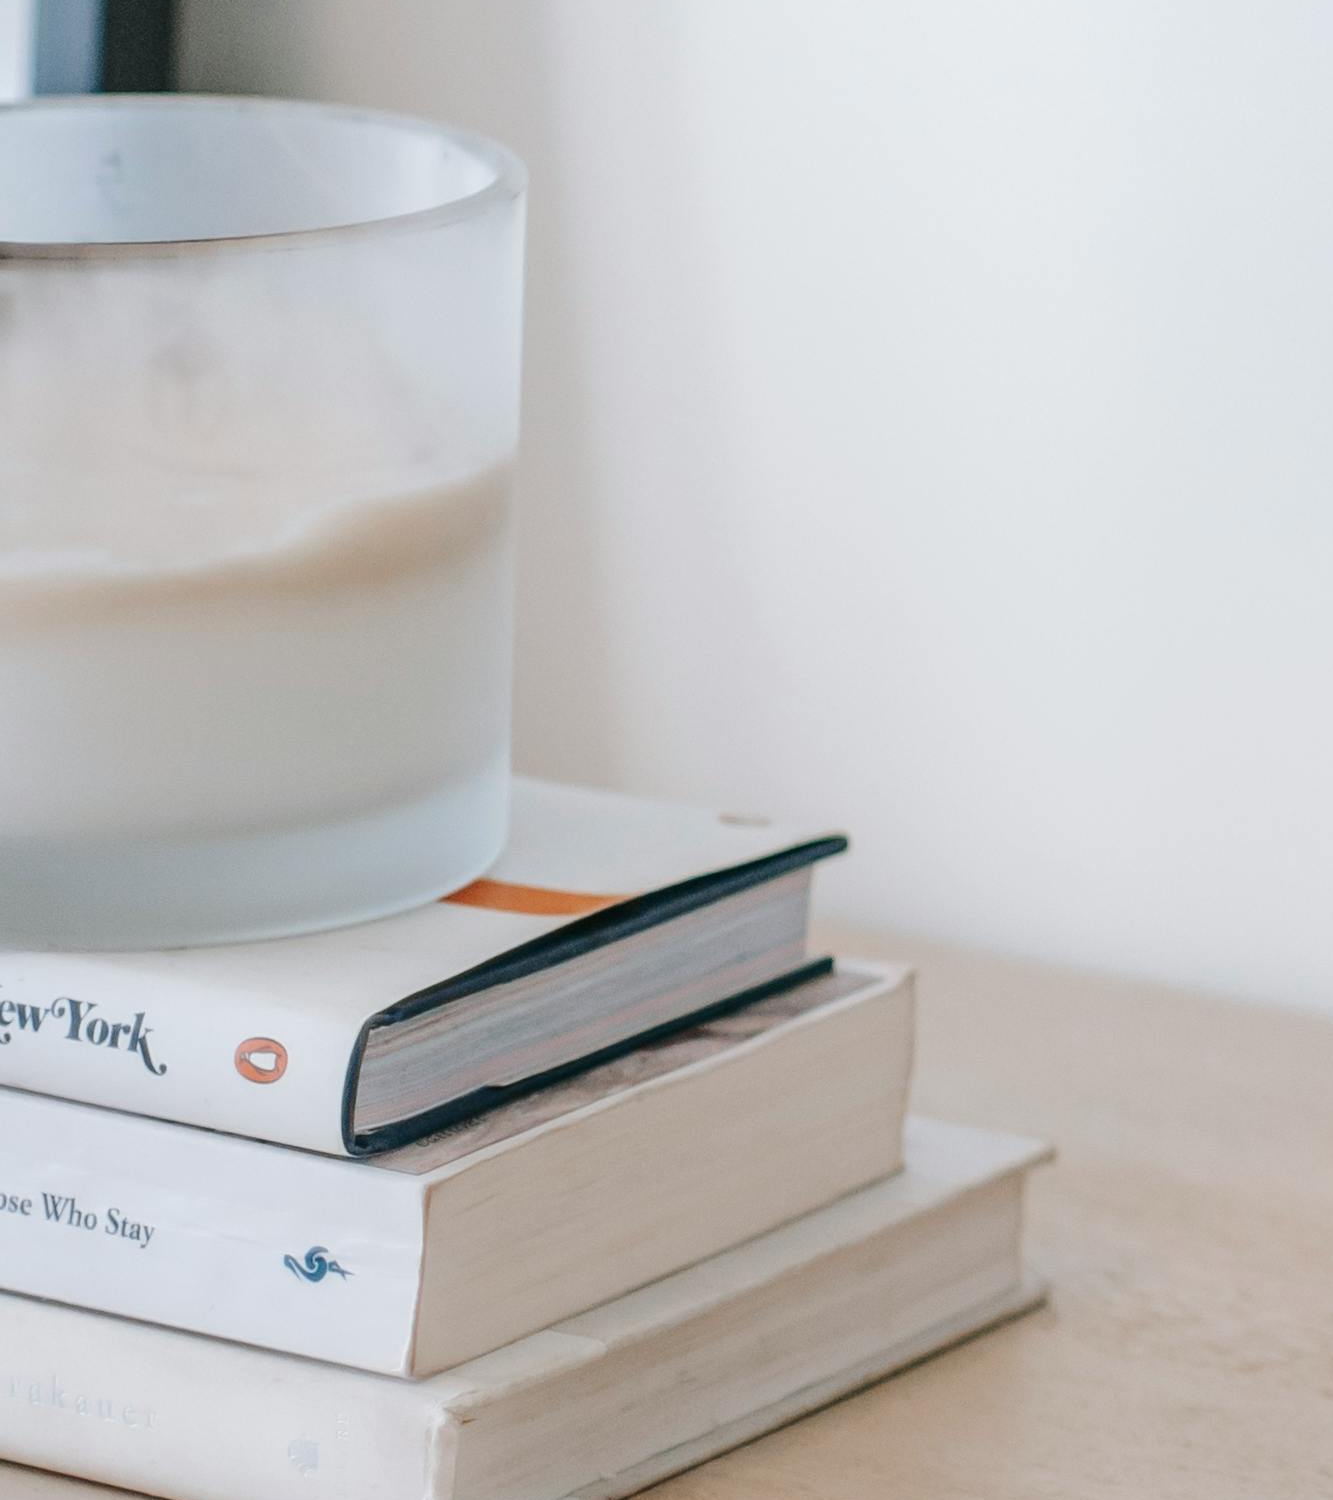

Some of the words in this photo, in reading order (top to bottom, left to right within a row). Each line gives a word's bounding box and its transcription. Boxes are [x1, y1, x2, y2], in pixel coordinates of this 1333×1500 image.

[0, 998, 50, 1045] ew
[51, 997, 167, 1076] York
[41, 1192, 97, 1230] Who
[105, 1208, 155, 1248] Stay
